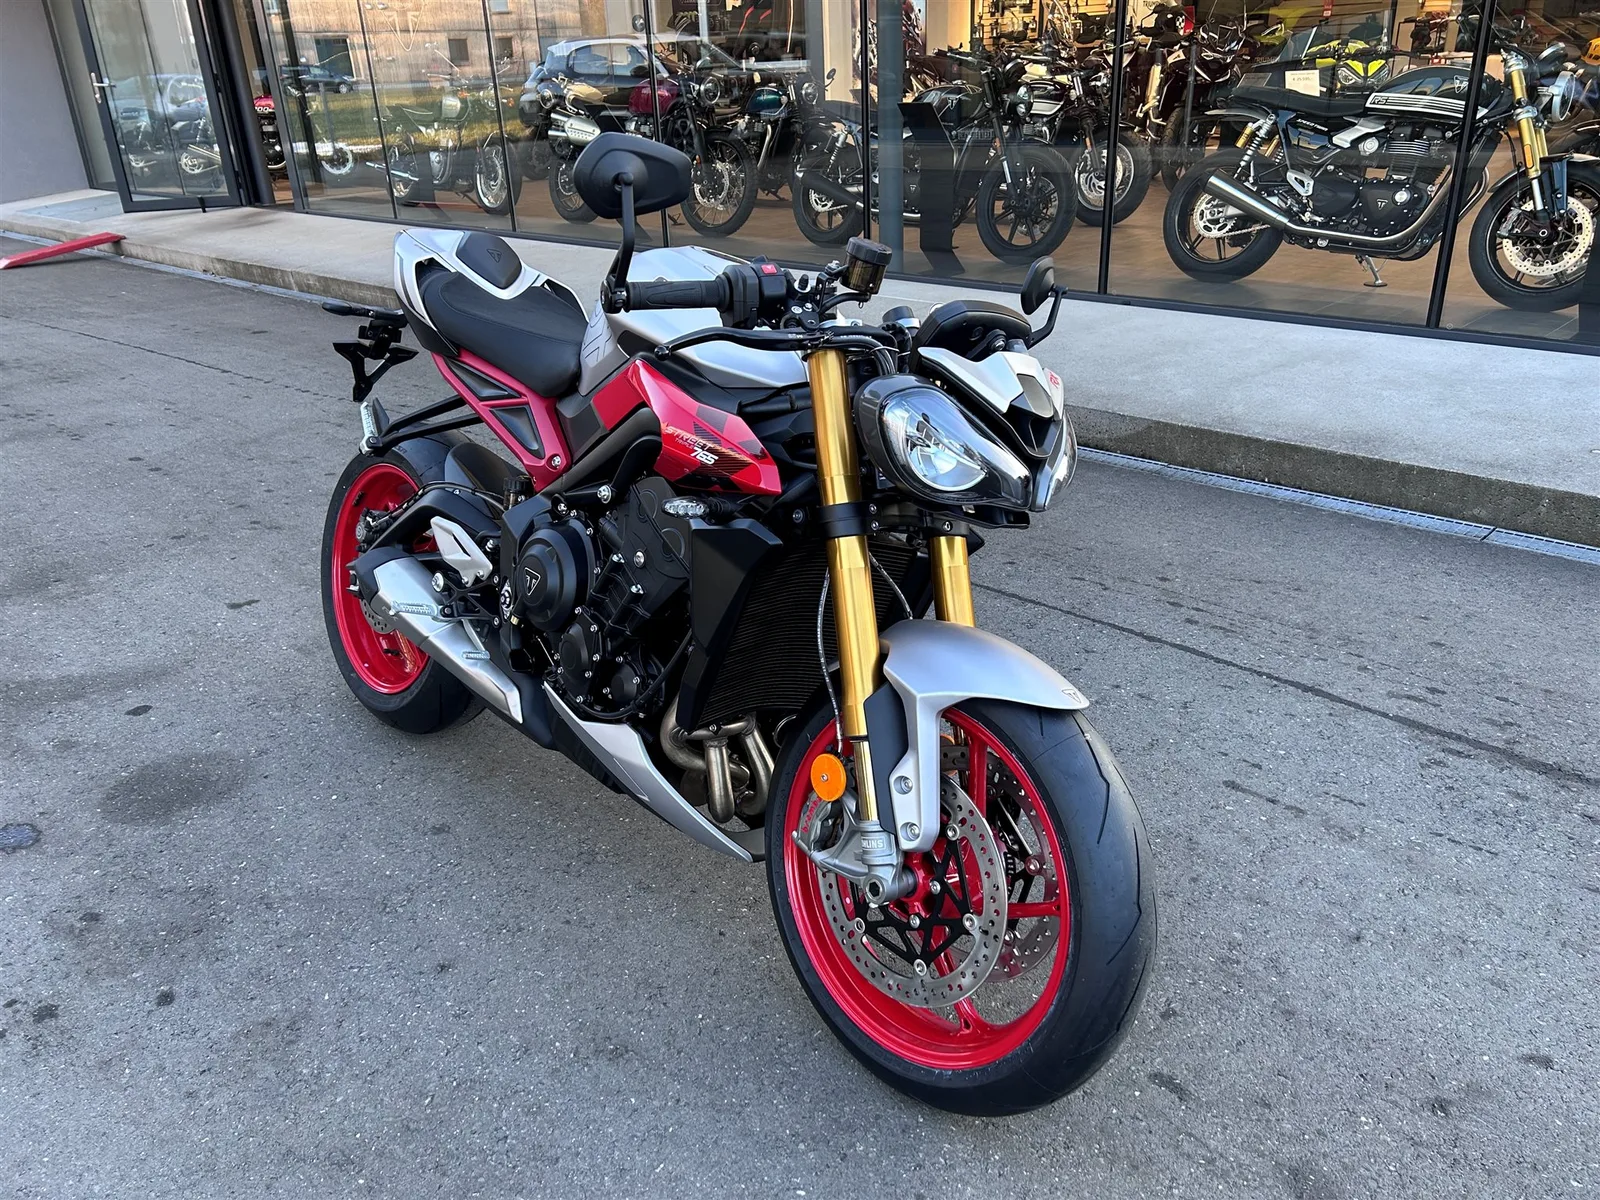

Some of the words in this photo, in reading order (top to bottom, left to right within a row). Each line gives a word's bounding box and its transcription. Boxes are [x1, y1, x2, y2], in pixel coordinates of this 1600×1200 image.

[1370, 96, 1387, 105] RS
[665, 425, 714, 451] STREET
[690, 446, 719, 465] 765
